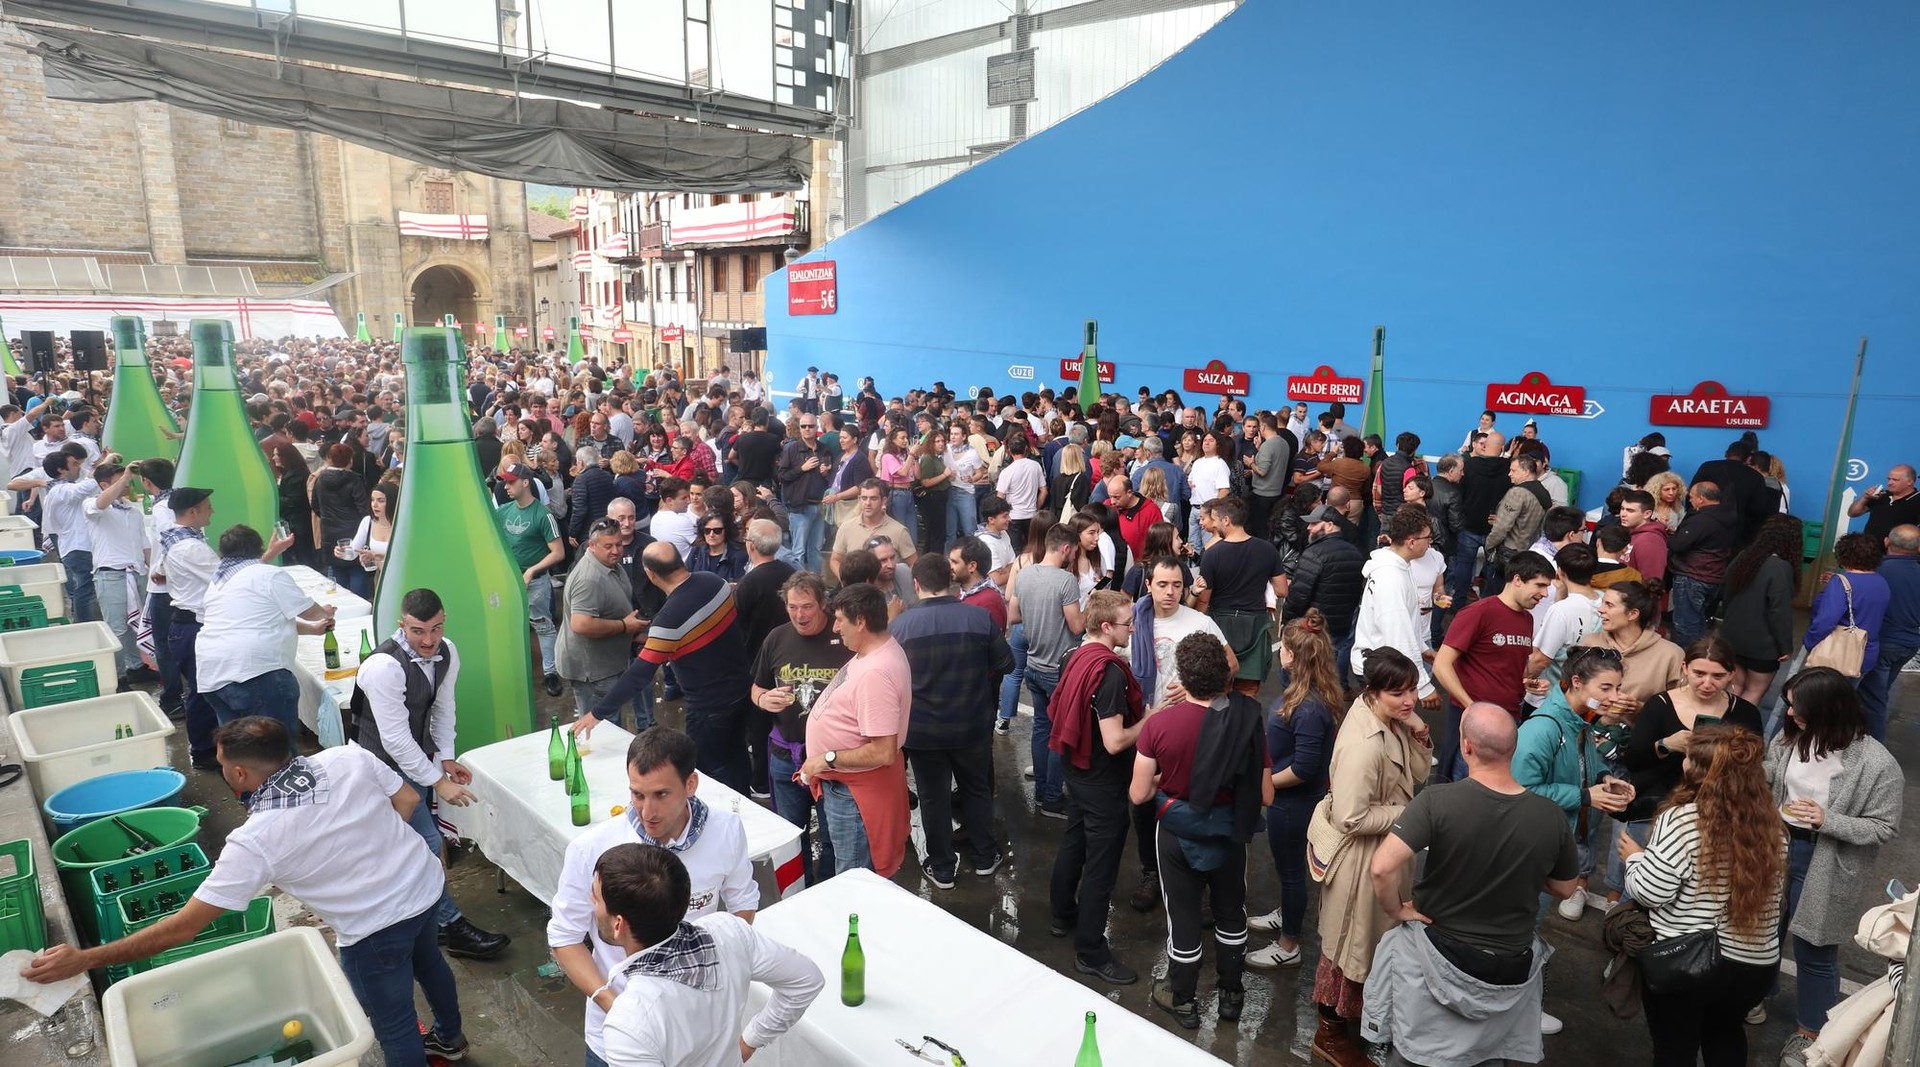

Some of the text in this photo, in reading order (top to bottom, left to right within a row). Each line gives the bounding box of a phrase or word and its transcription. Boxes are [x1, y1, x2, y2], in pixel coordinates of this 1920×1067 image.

[821, 289, 835, 309] 5€
[1012, 368, 1032, 377] LUZE
[1198, 372, 1234, 386] SAIZAR
[1289, 382, 1360, 396] AIALDE BERRI
[1496, 391, 1571, 408] AGINAGA
[1550, 407, 1578, 415] USURBIL
[1668, 399, 1747, 414] ARAETA
[1726, 418, 1762, 426] USURBIL
[1848, 464, 1859, 475] 3
[1506, 634, 1532, 647] ELEME
